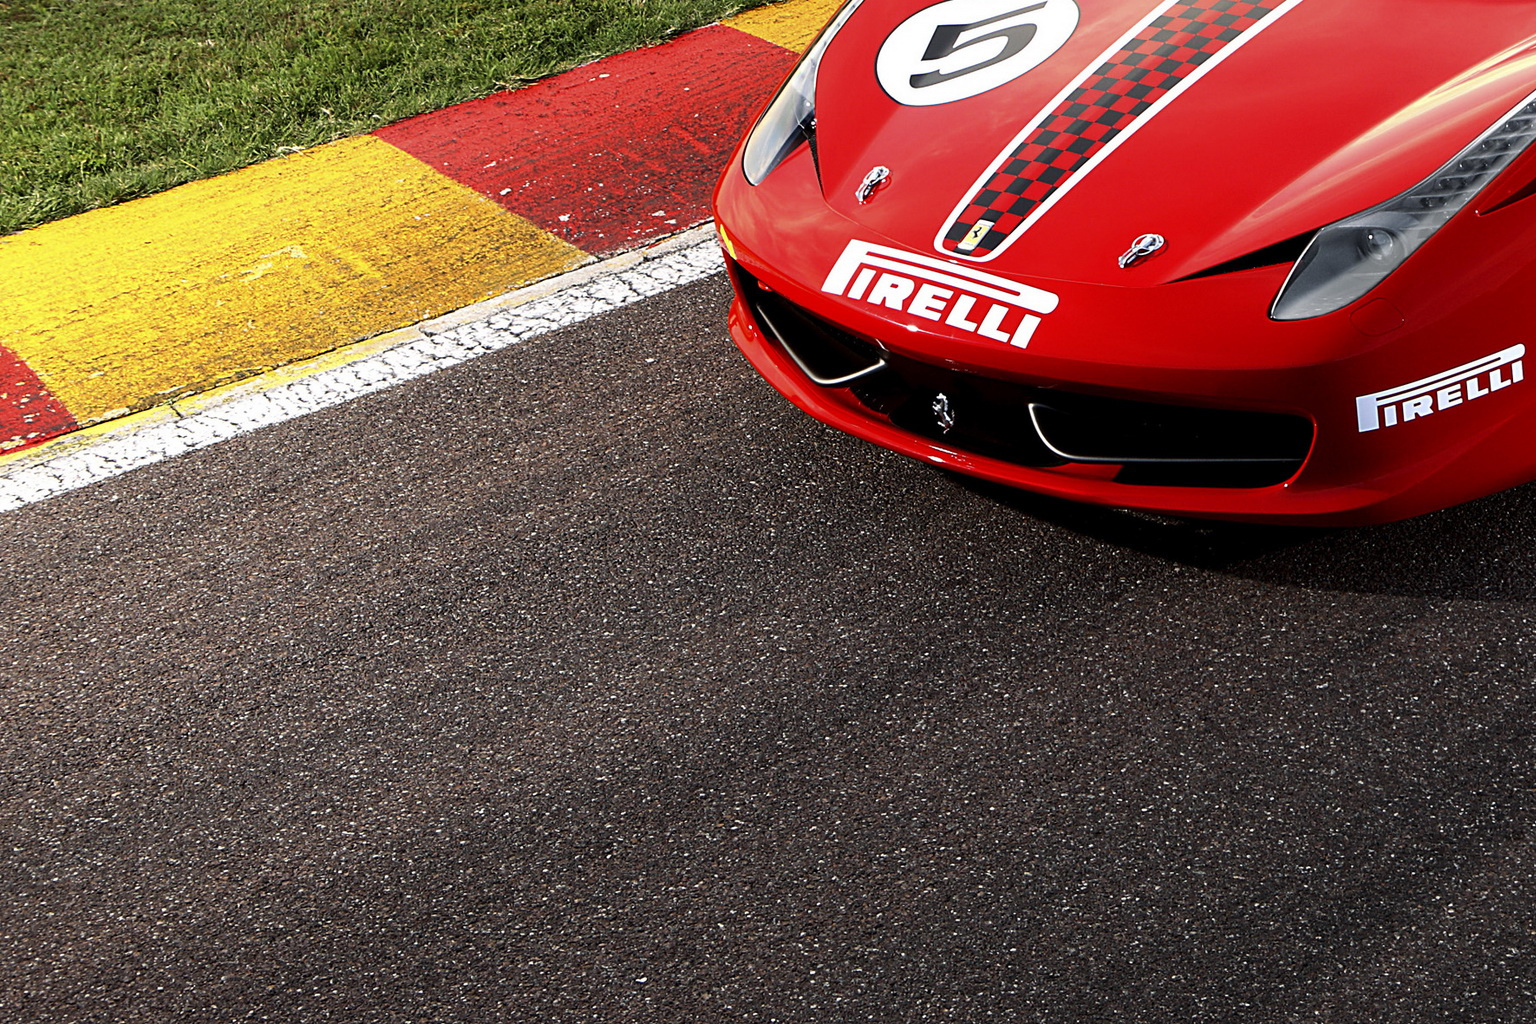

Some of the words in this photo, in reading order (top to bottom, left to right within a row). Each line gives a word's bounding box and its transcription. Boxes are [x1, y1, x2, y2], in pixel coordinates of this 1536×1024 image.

[909, 1, 1048, 89] 5
[821, 239, 1059, 349] PIRELLI
[1356, 343, 1526, 432] PIRELLI
